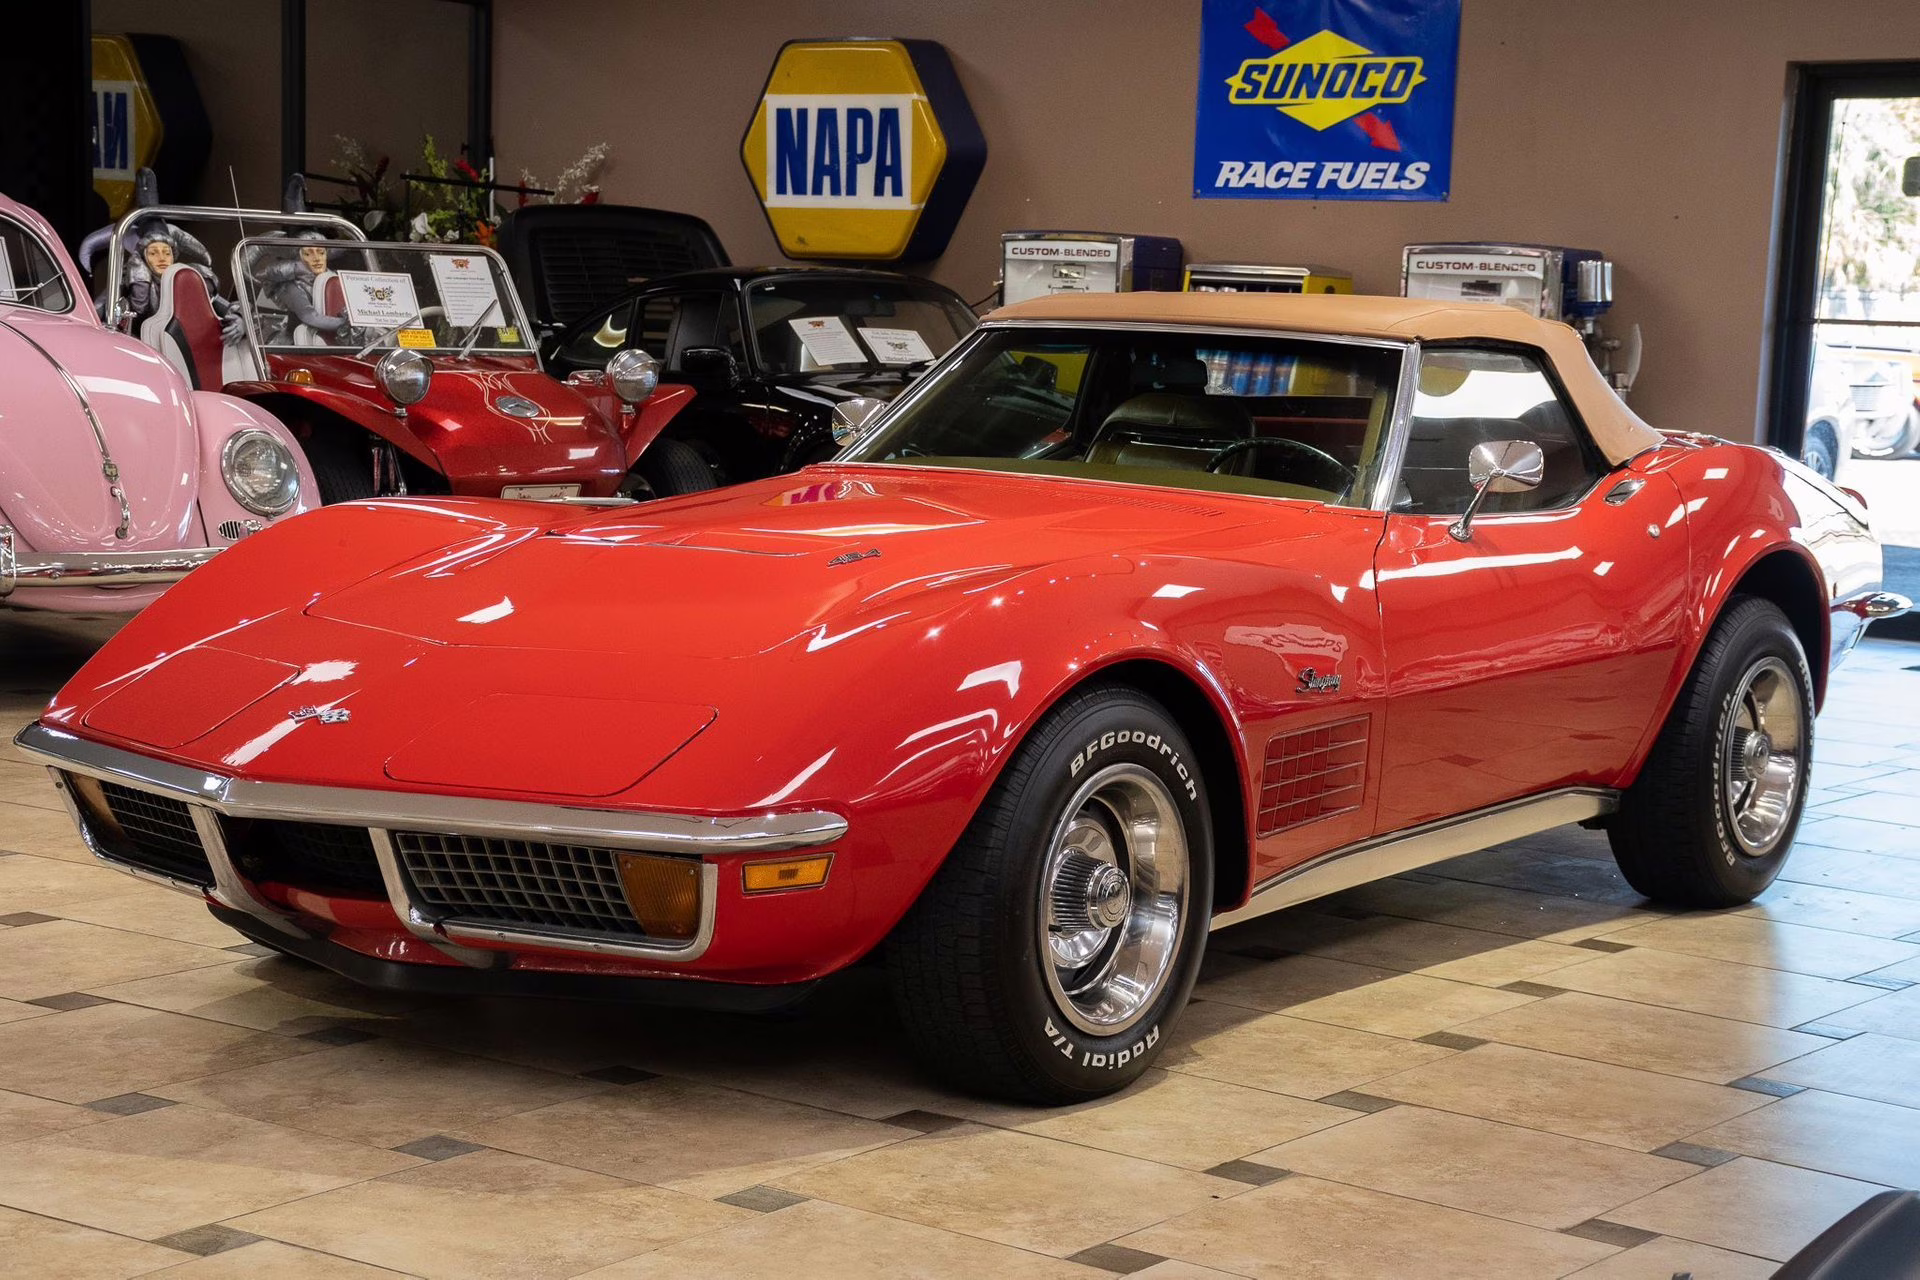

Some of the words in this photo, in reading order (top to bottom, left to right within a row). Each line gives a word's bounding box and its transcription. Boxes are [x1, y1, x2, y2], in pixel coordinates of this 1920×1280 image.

[1235, 62, 1416, 99] SUNOCO
[776, 108, 903, 197] NAPA
[1214, 161, 1317, 189] RACE
[1316, 161, 1431, 190] FUELS
[1011, 247, 1111, 257] CUSTOM-BLENDED
[1070, 730, 1197, 801] BFGoodrich
[1712, 692, 1736, 867] BFGoodrich
[1044, 1016, 1074, 1059] T/A
[1082, 1024, 1160, 1070] Radial
